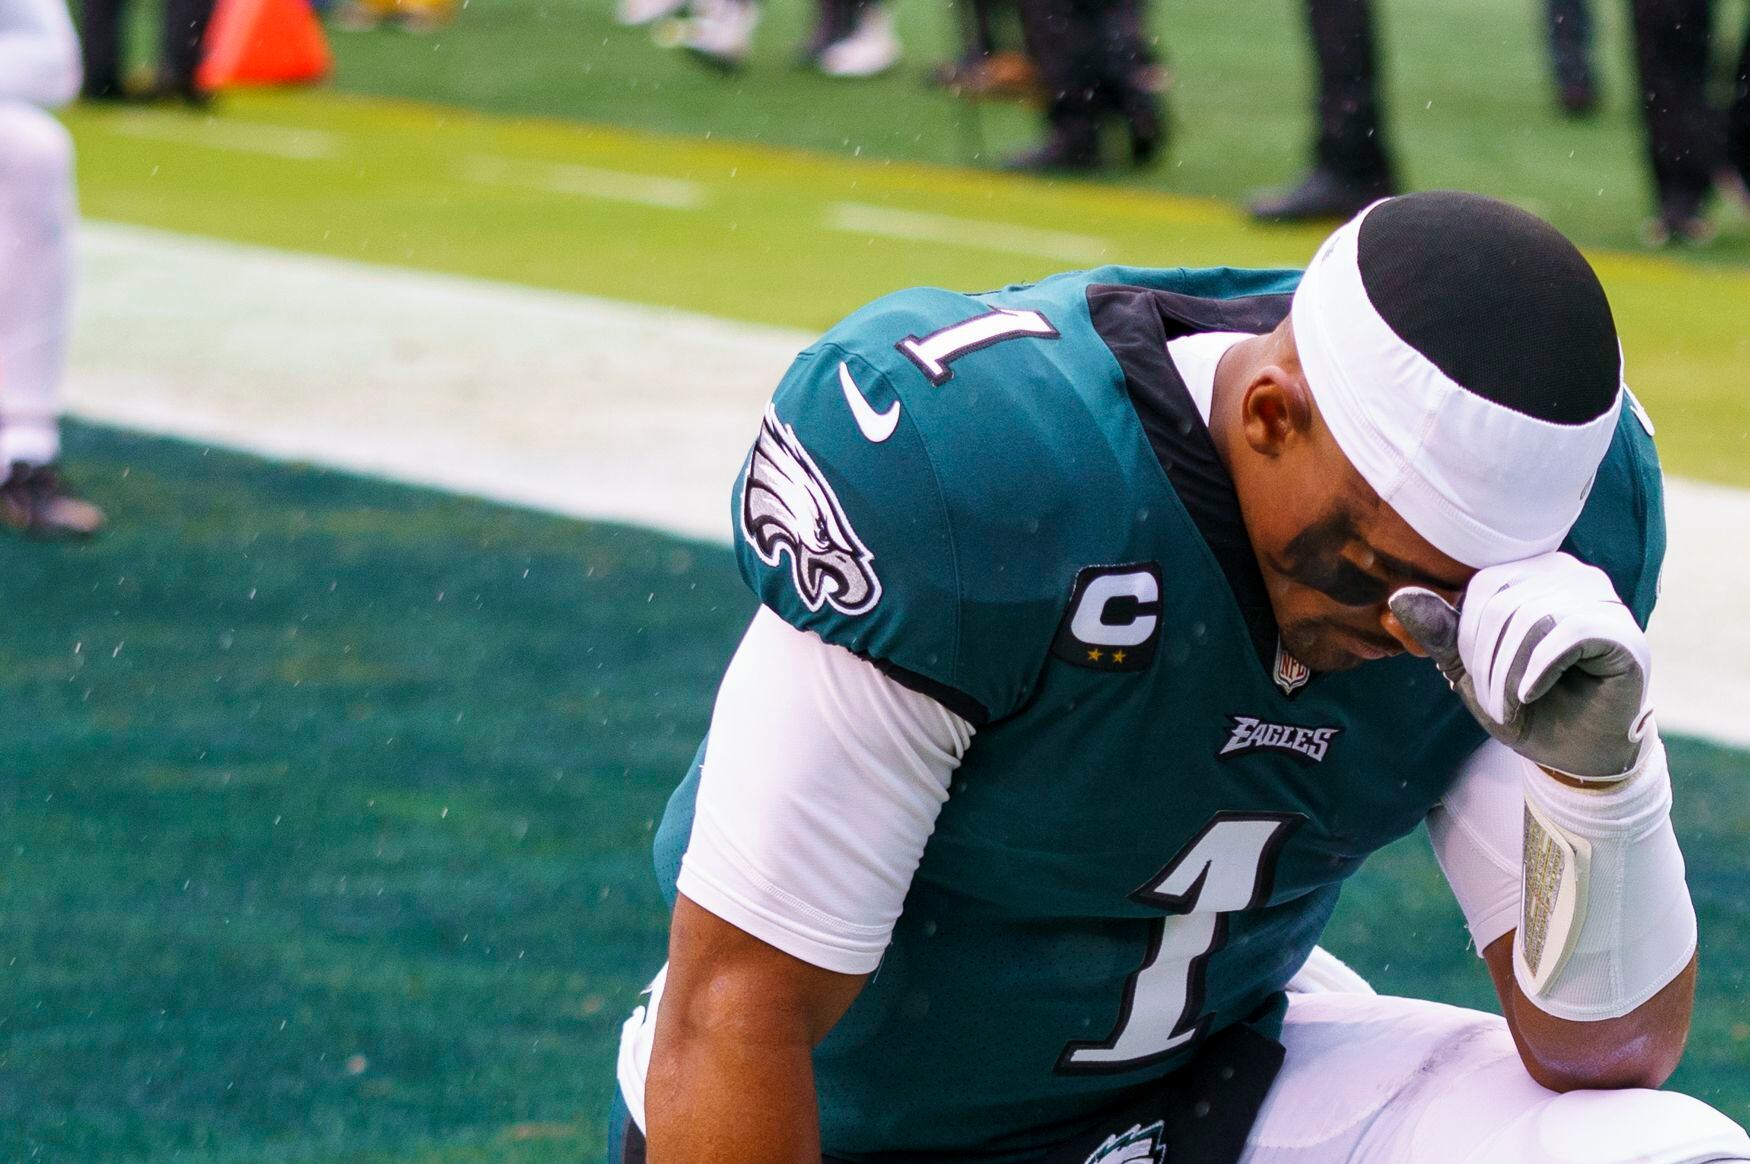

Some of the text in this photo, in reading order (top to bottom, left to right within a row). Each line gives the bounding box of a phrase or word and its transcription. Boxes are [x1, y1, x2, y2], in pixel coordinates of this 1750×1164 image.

[896, 306, 1060, 385] 1
[1070, 571, 1159, 646] C
[1218, 715, 1341, 763] EAGLES
[1054, 812, 1307, 1075] 1
